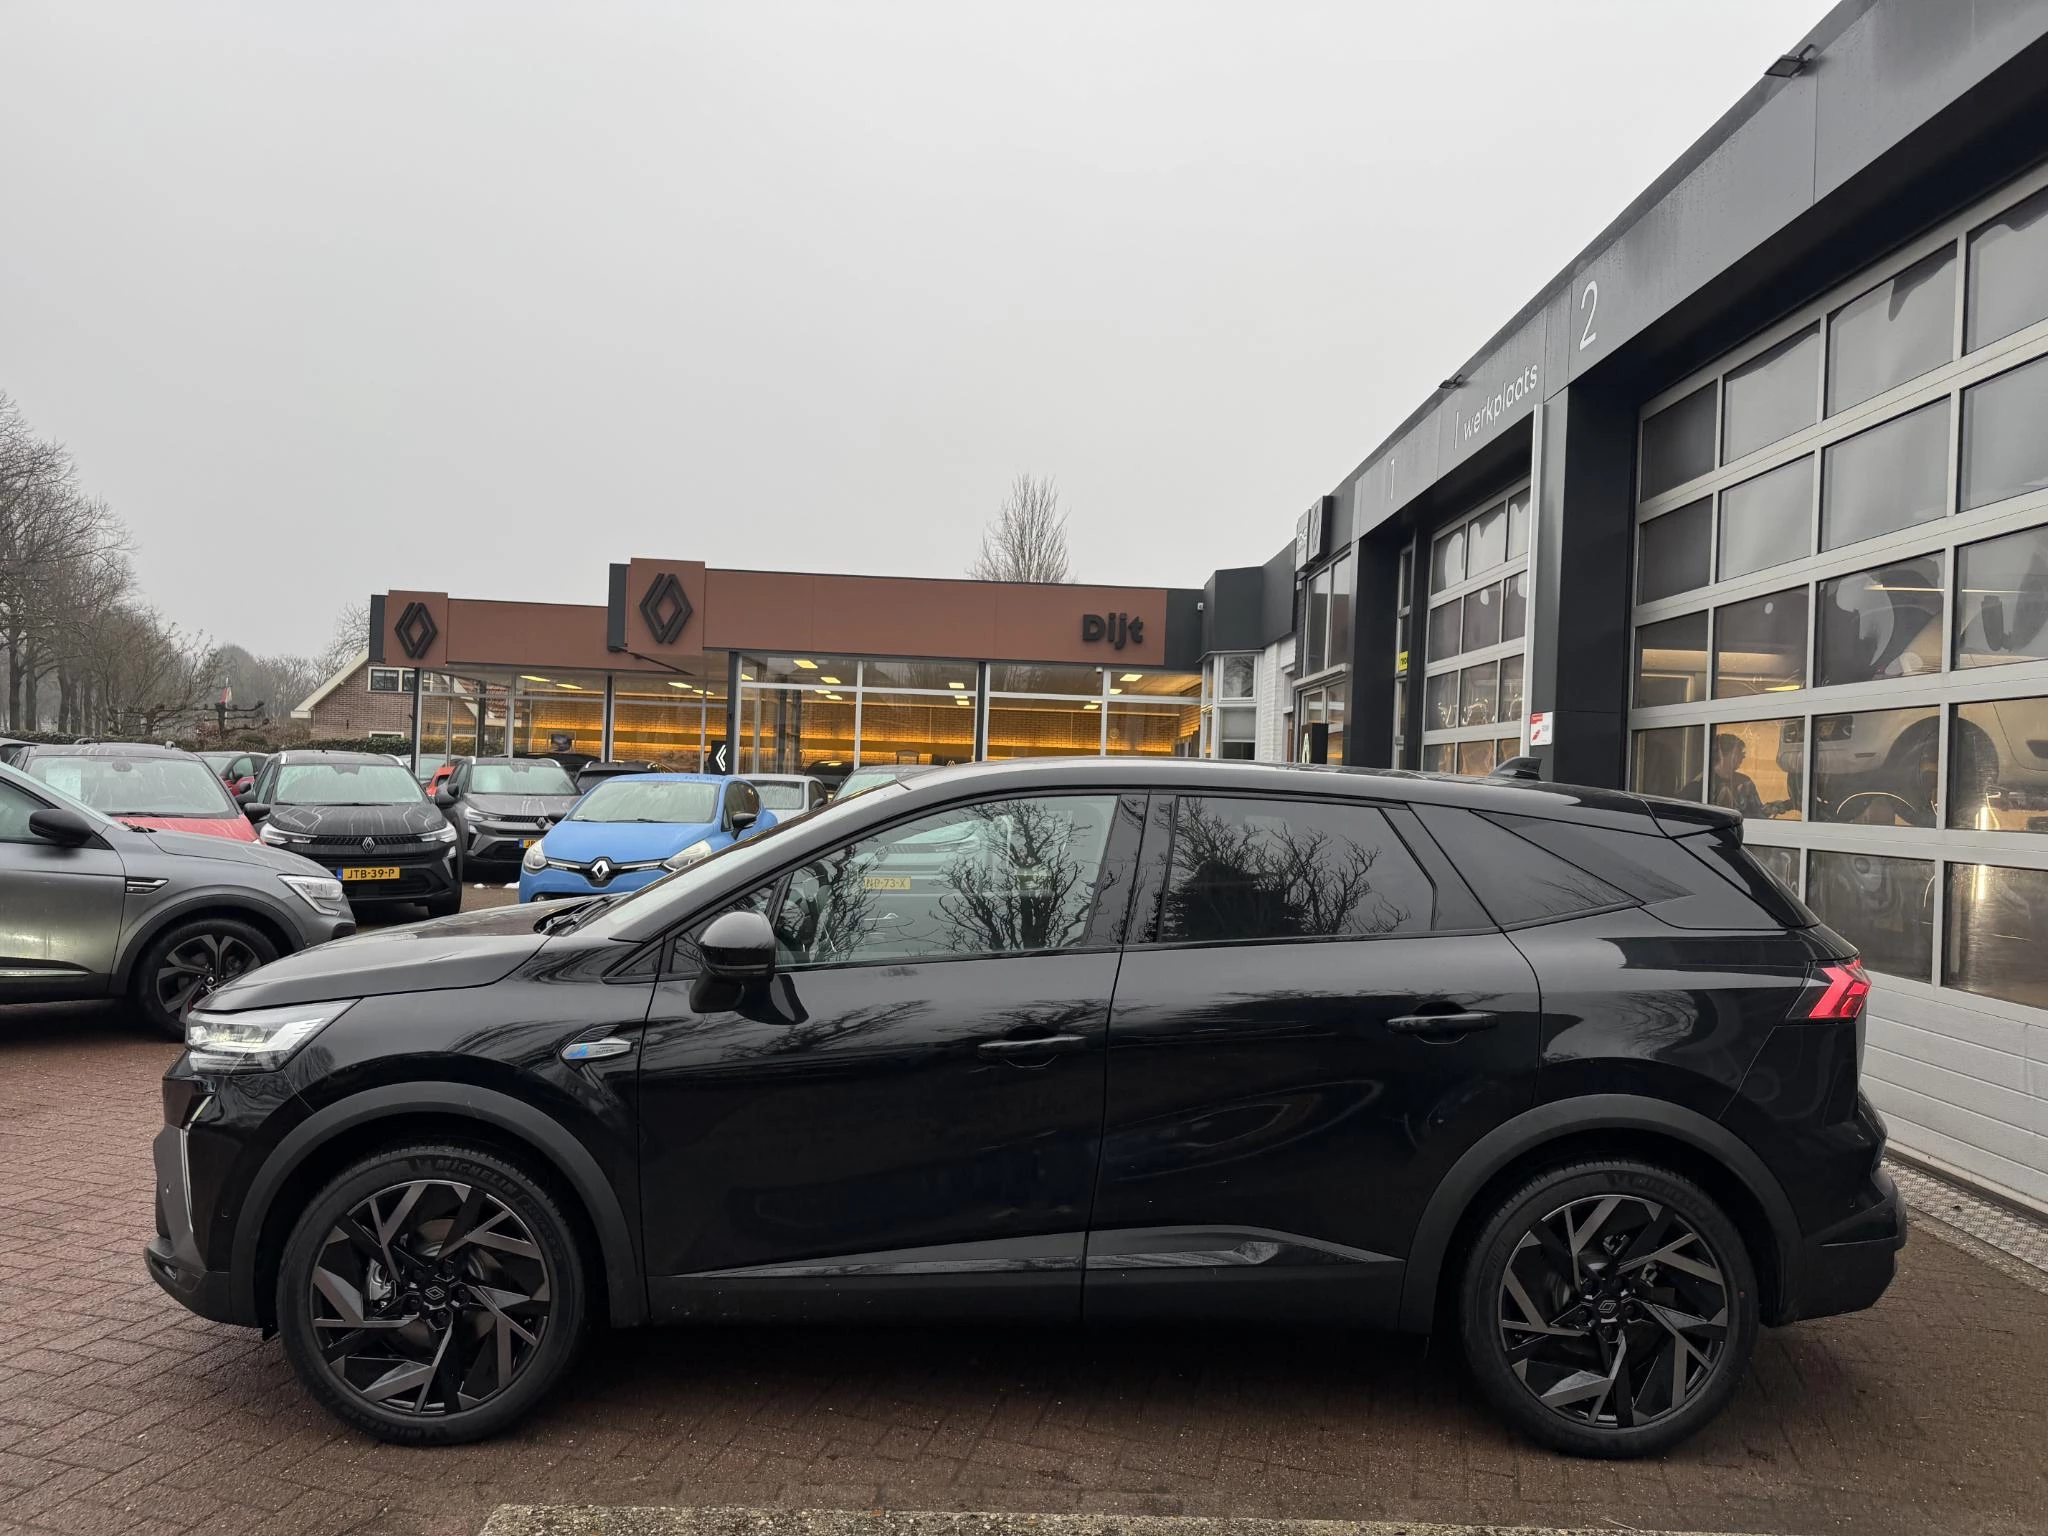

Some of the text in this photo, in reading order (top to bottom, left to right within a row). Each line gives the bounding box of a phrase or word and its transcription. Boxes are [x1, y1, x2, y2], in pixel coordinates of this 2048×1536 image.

[1580, 280, 1598, 351] 2
[1464, 365, 1537, 441] werkplaats
[1083, 612, 1144, 650] Dijt
[348, 868, 395, 879] JTB-39-P
[435, 1158, 518, 1195] MICHELIN
